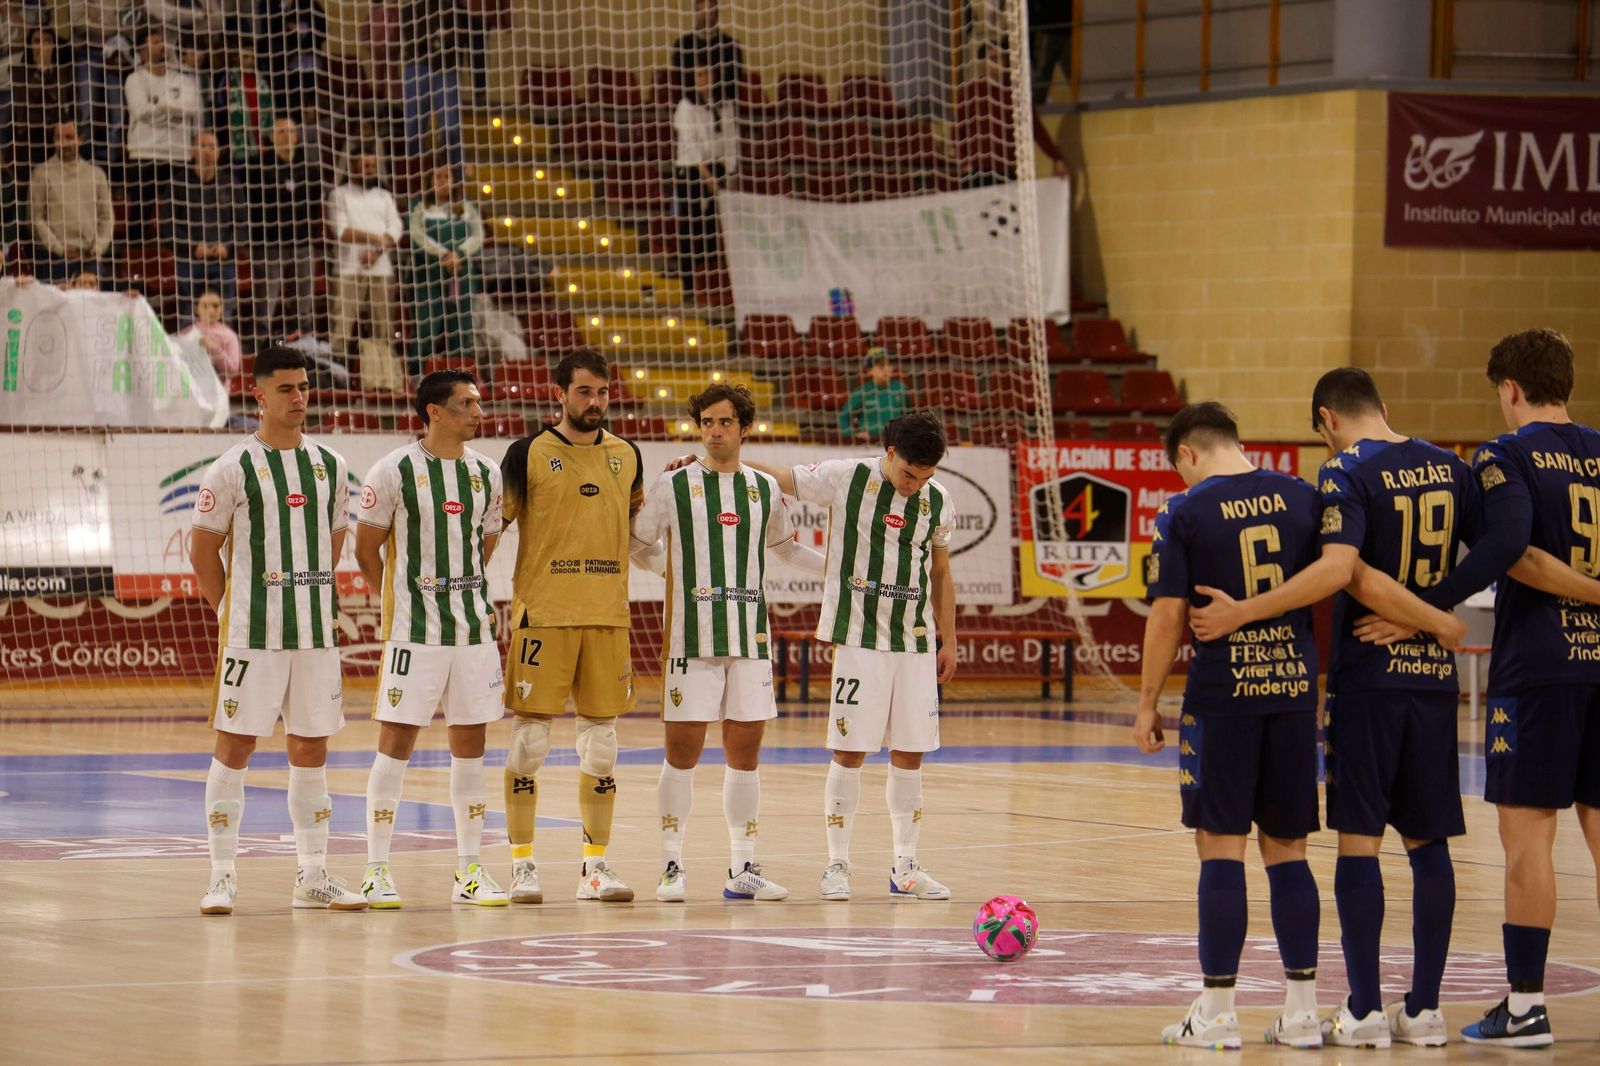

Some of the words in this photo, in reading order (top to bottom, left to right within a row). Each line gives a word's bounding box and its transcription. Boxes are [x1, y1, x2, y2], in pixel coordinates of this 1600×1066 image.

[1404, 203, 1480, 224] Instituto
[1485, 205, 1575, 230] Municipal
[1114, 448, 1136, 471] DE
[1278, 451, 1292, 473] 4
[1531, 451, 1585, 477] SANTA
[1584, 457, 1600, 478] C
[1381, 460, 1454, 489] R.ORZÁEZ
[1220, 493, 1287, 520] NOVOA
[1394, 490, 1454, 587] 19
[1043, 545, 1123, 561] RUTA
[1239, 524, 1284, 600] 6
[585, 566, 621, 574] HUMANIDA
[449, 581, 484, 591] HUMANIDA
[880, 583, 919, 594] PATRIMONIO
[52, 640, 177, 668] Córdoba
[390, 647, 412, 676] 10
[520, 637, 543, 666] 12
[982, 642, 1016, 664] de
[223, 657, 249, 687] 27
[836, 677, 859, 705] 22
